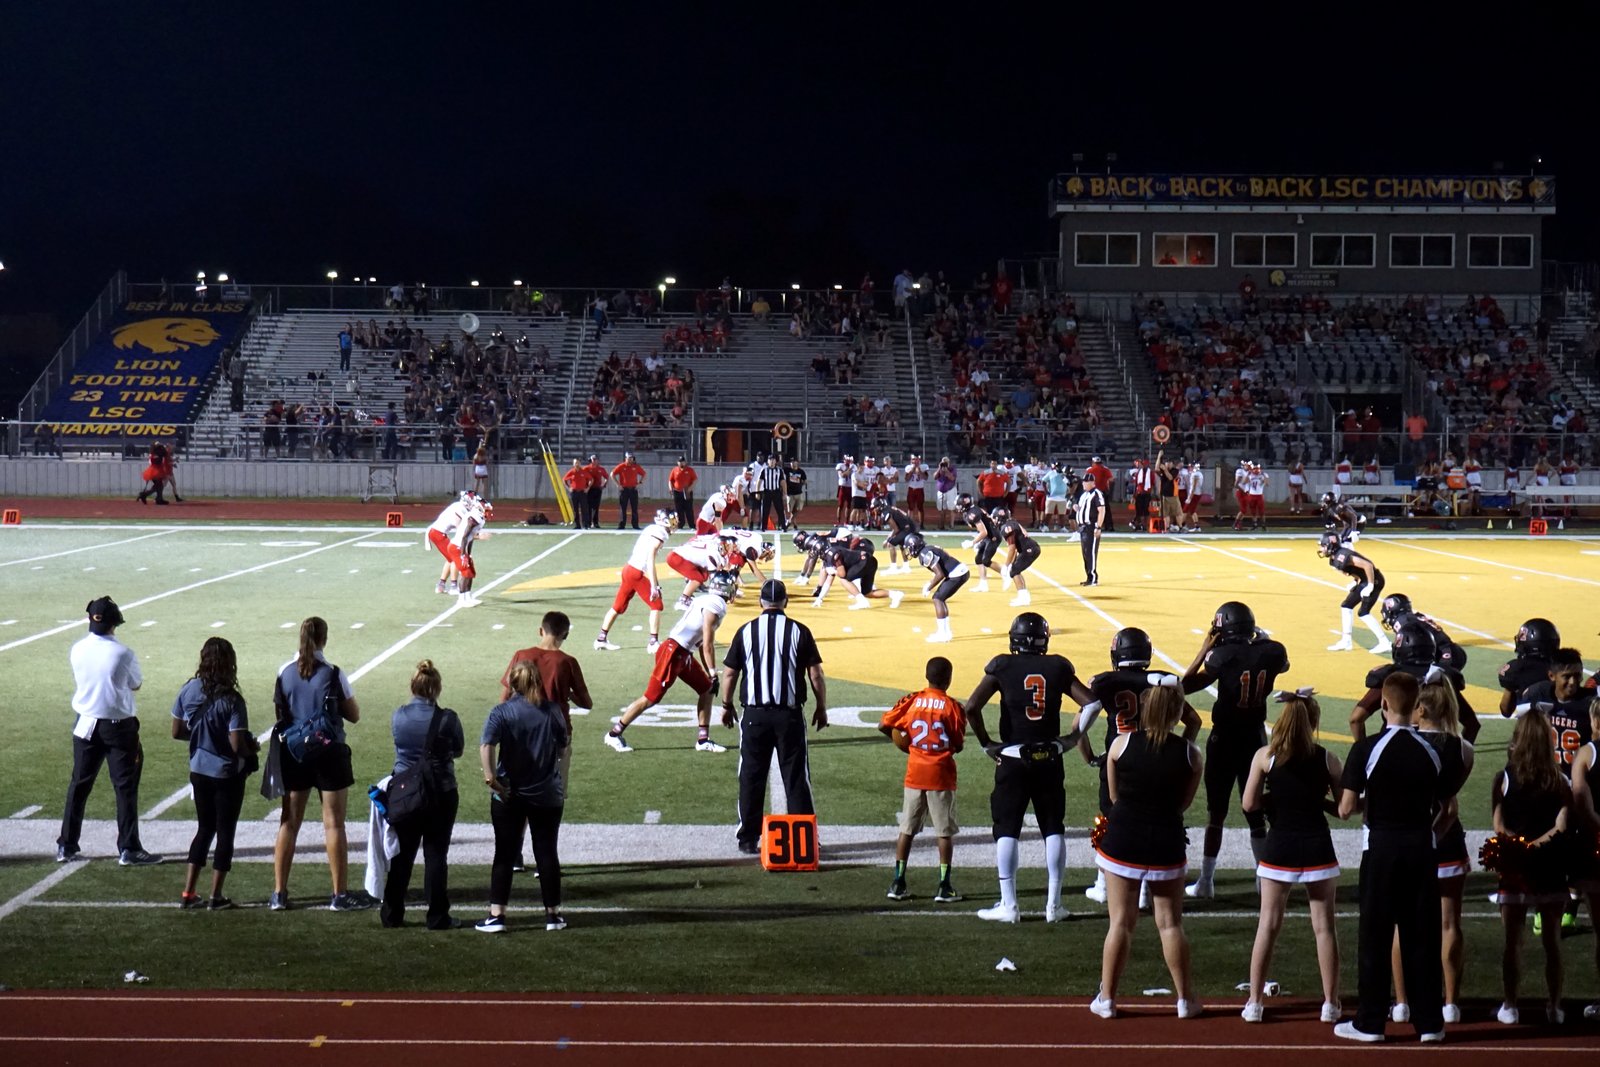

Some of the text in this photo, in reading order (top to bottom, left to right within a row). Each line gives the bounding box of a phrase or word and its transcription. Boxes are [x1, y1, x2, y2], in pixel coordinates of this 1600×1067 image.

[1089, 176, 1523, 199] BACK to BACK to BACK LSC CHAMPIONS
[125, 302, 245, 312] BEST IN CLASS
[114, 359, 181, 370] LION
[69, 374, 200, 386] FOOTBALL
[69, 390, 188, 402] 23 TIME
[89, 406, 146, 418] LSC
[34, 423, 177, 436] HAMPONS
[6, 511, 17, 523] 10
[388, 513, 401, 526] 20
[1532, 521, 1546, 533] 50
[1236, 669, 1268, 709] 11
[1023, 673, 1047, 721] 3
[1114, 688, 1146, 735] 2
[1551, 715, 1578, 729] IGERS
[911, 719, 950, 751] 23
[768, 821, 815, 864] 30
